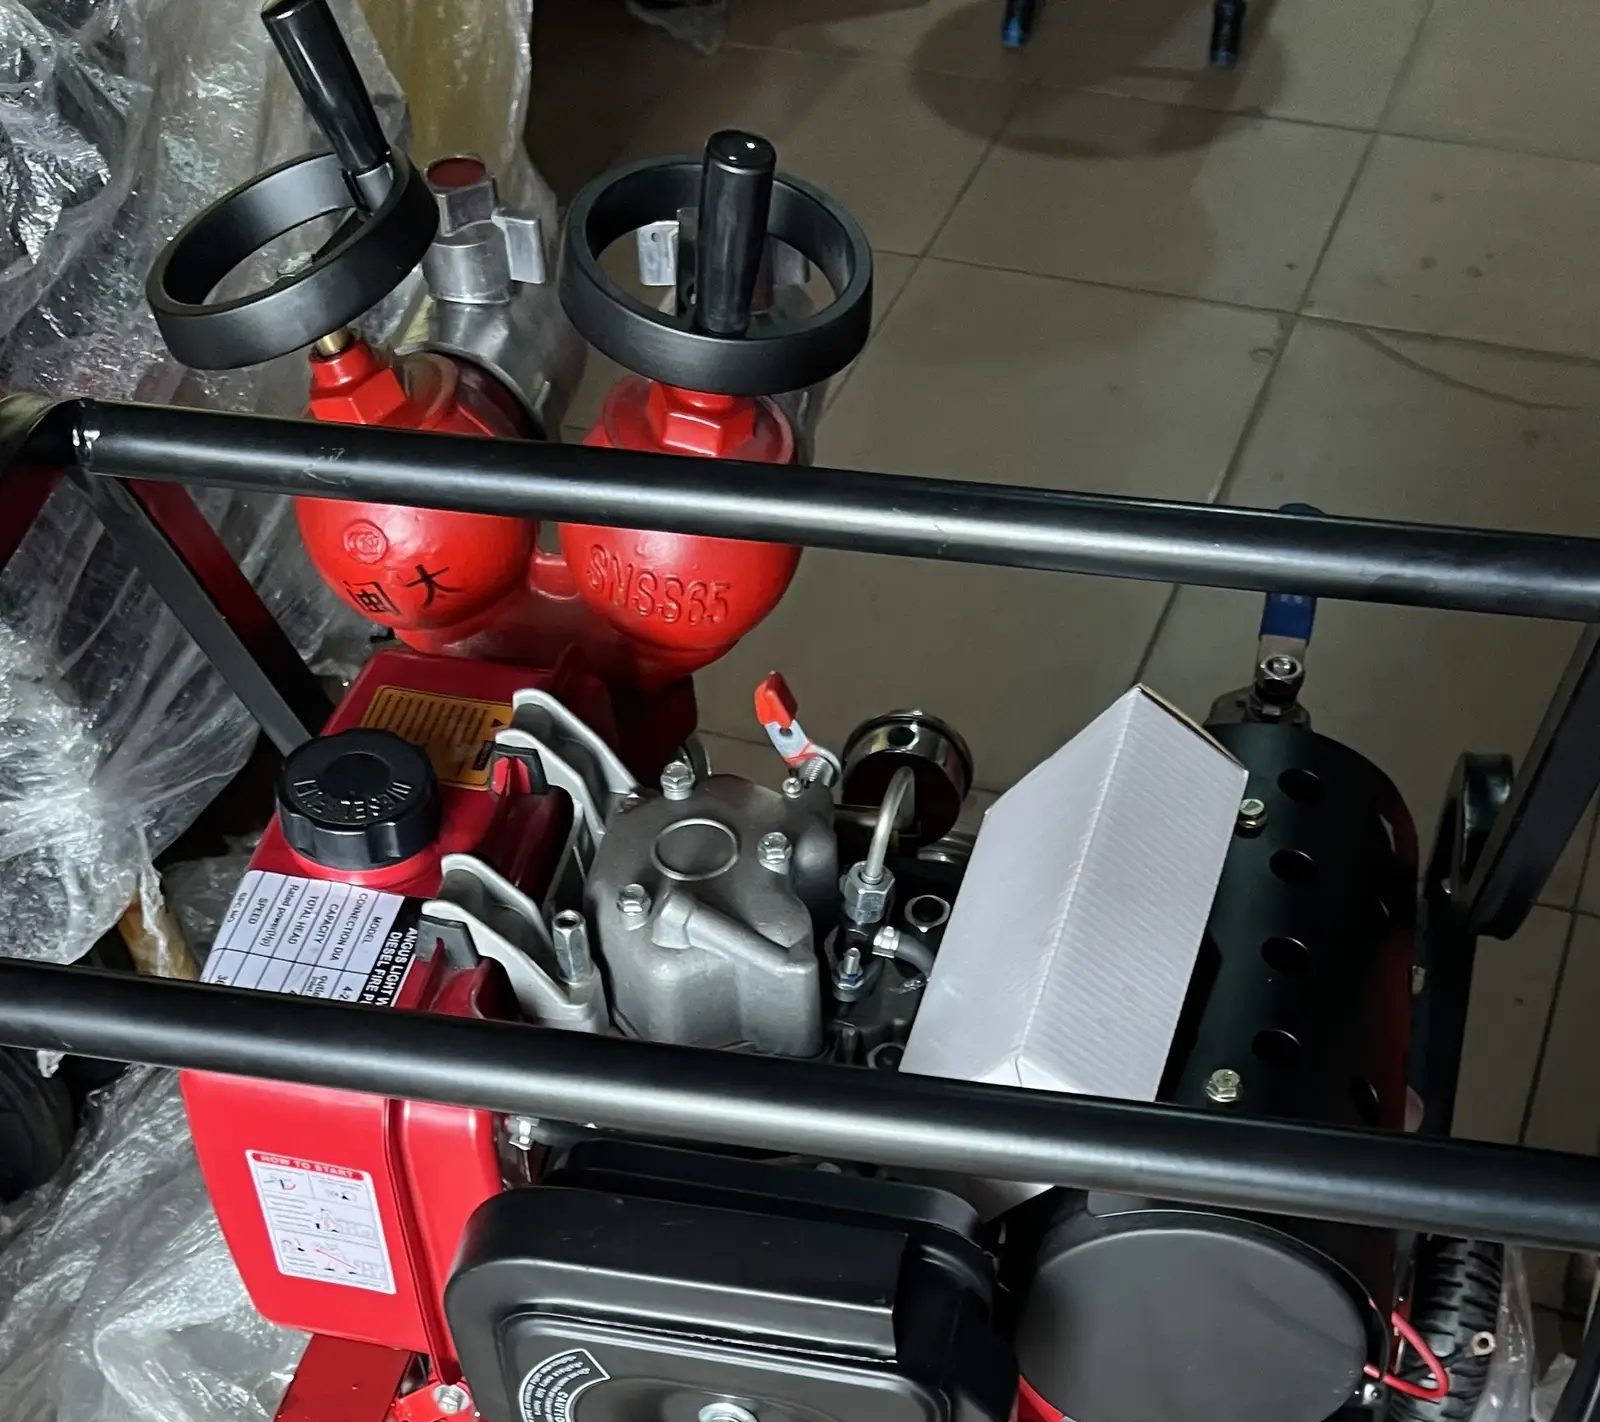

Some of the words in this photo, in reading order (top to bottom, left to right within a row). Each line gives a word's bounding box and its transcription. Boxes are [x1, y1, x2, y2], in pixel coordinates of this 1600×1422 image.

[282, 884, 299, 907] Rated
[300, 895, 318, 921] TOTAL
[249, 897, 268, 925] SPEED
[315, 903, 339, 943] CAPACITY
[339, 892, 368, 946] CONNECTION
[288, 920, 305, 945] HEAD
[362, 916, 383, 944] MODEL
[329, 946, 343, 962] DIA
[377, 931, 403, 967] DIESEL
[395, 927, 418, 963] ANGUS
[365, 969, 386, 992] FIRE
[381, 965, 404, 996] LIGHT
[260, 1155, 290, 1166] HOW
[295, 1161, 311, 1169] TO
[314, 1164, 354, 1178] START
